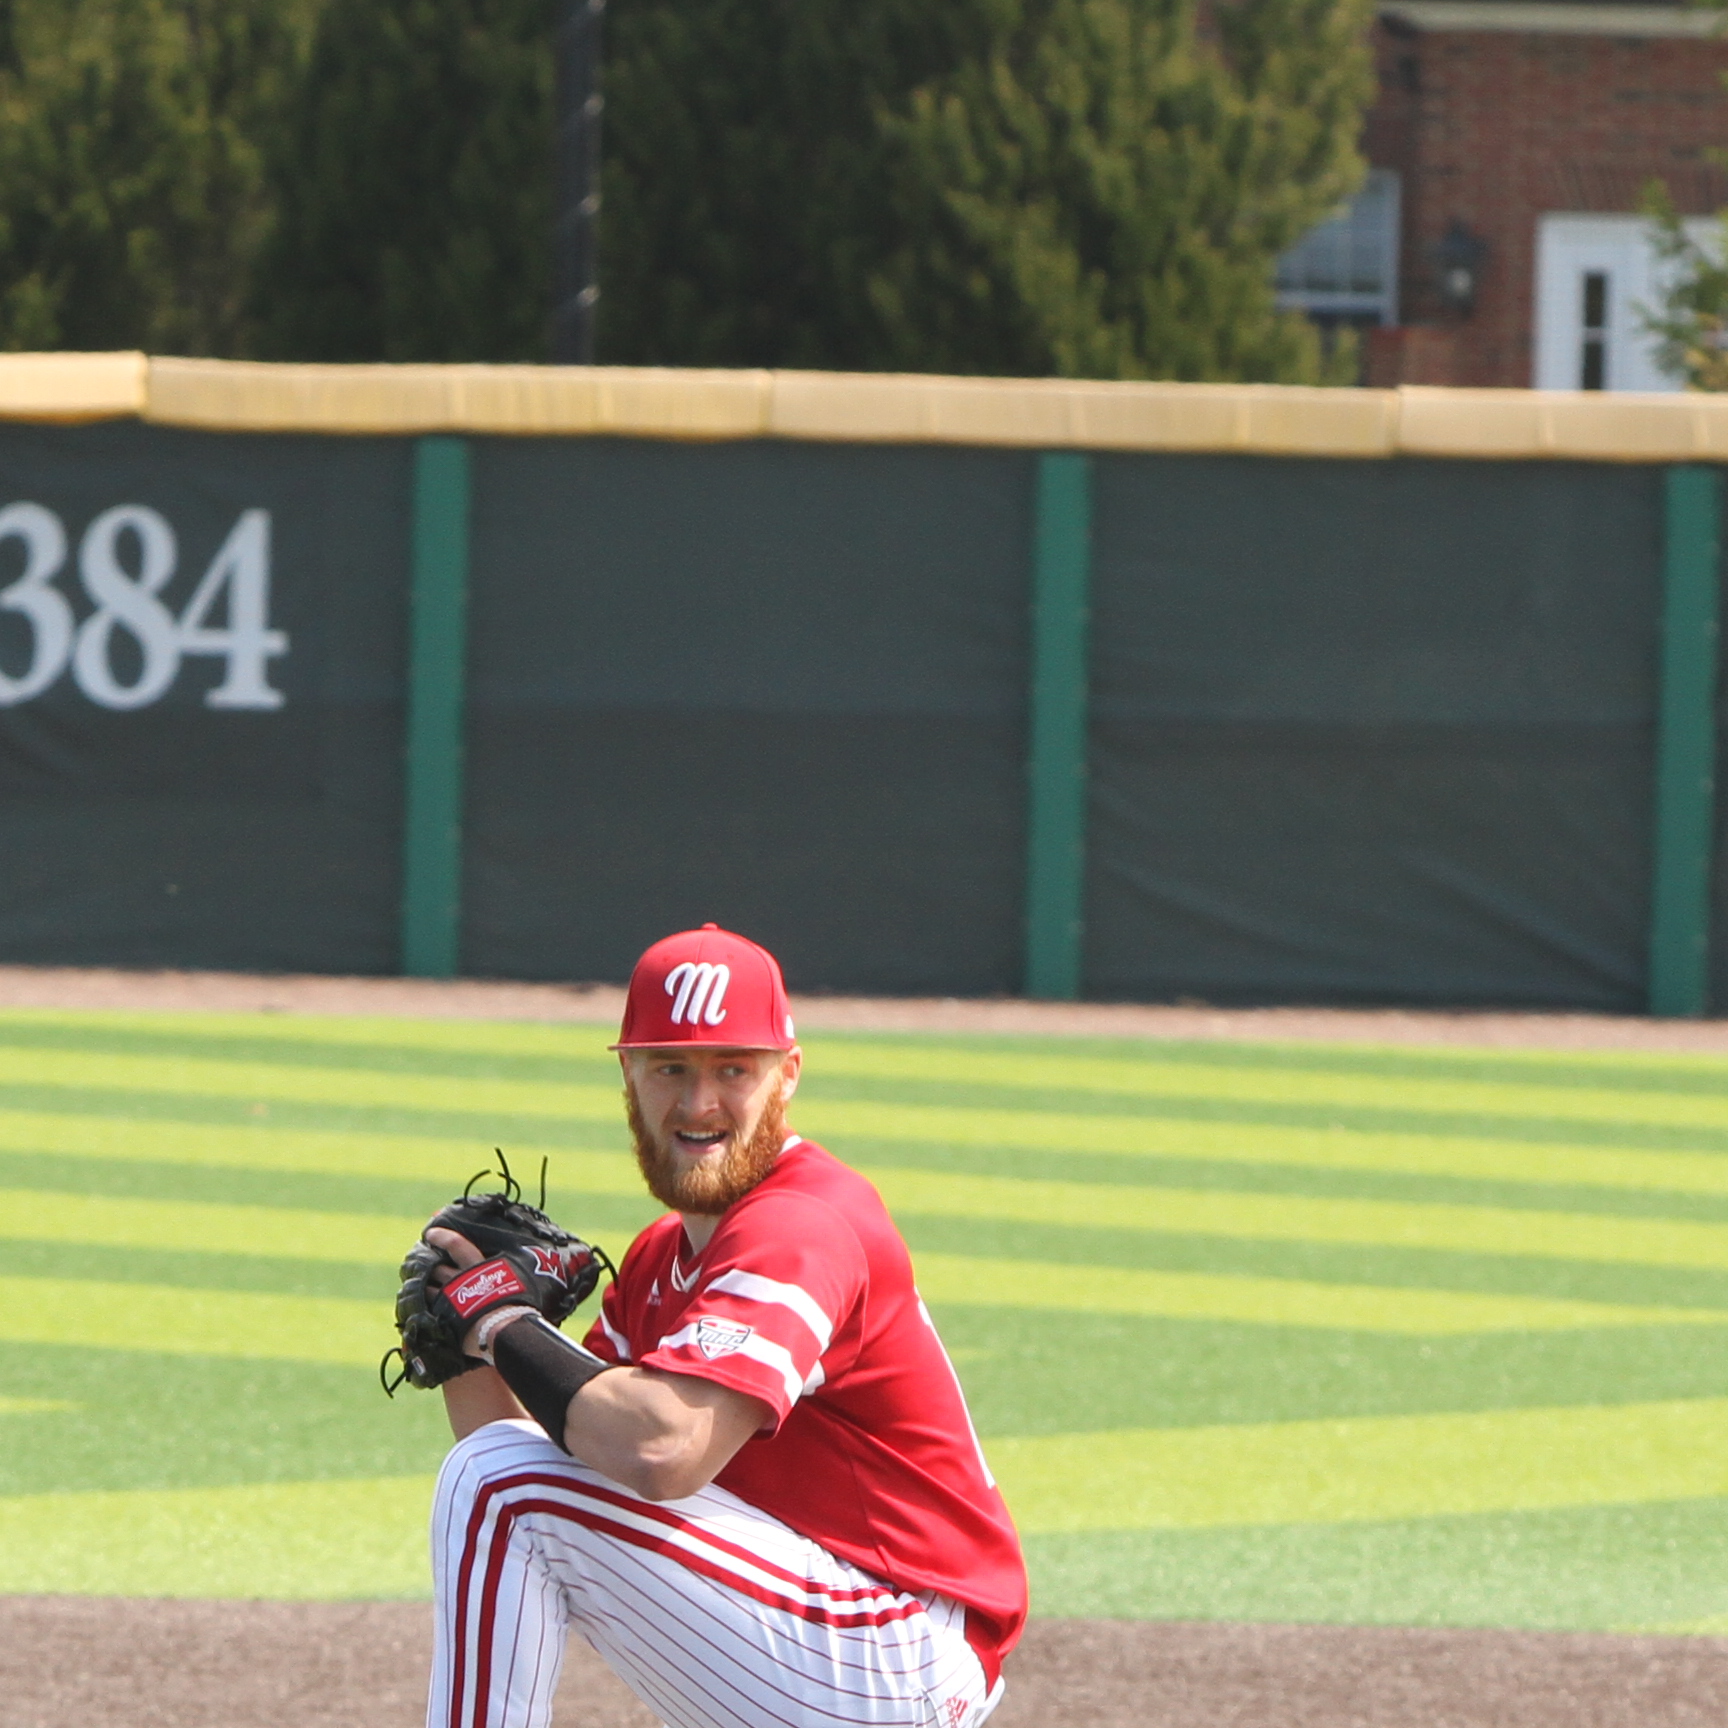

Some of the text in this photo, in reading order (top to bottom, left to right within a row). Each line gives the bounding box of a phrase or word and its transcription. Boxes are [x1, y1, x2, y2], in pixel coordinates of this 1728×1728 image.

[664, 961, 730, 1027] M
[456, 1268, 508, 1304] Rawlings
[520, 1244, 569, 1290] M
